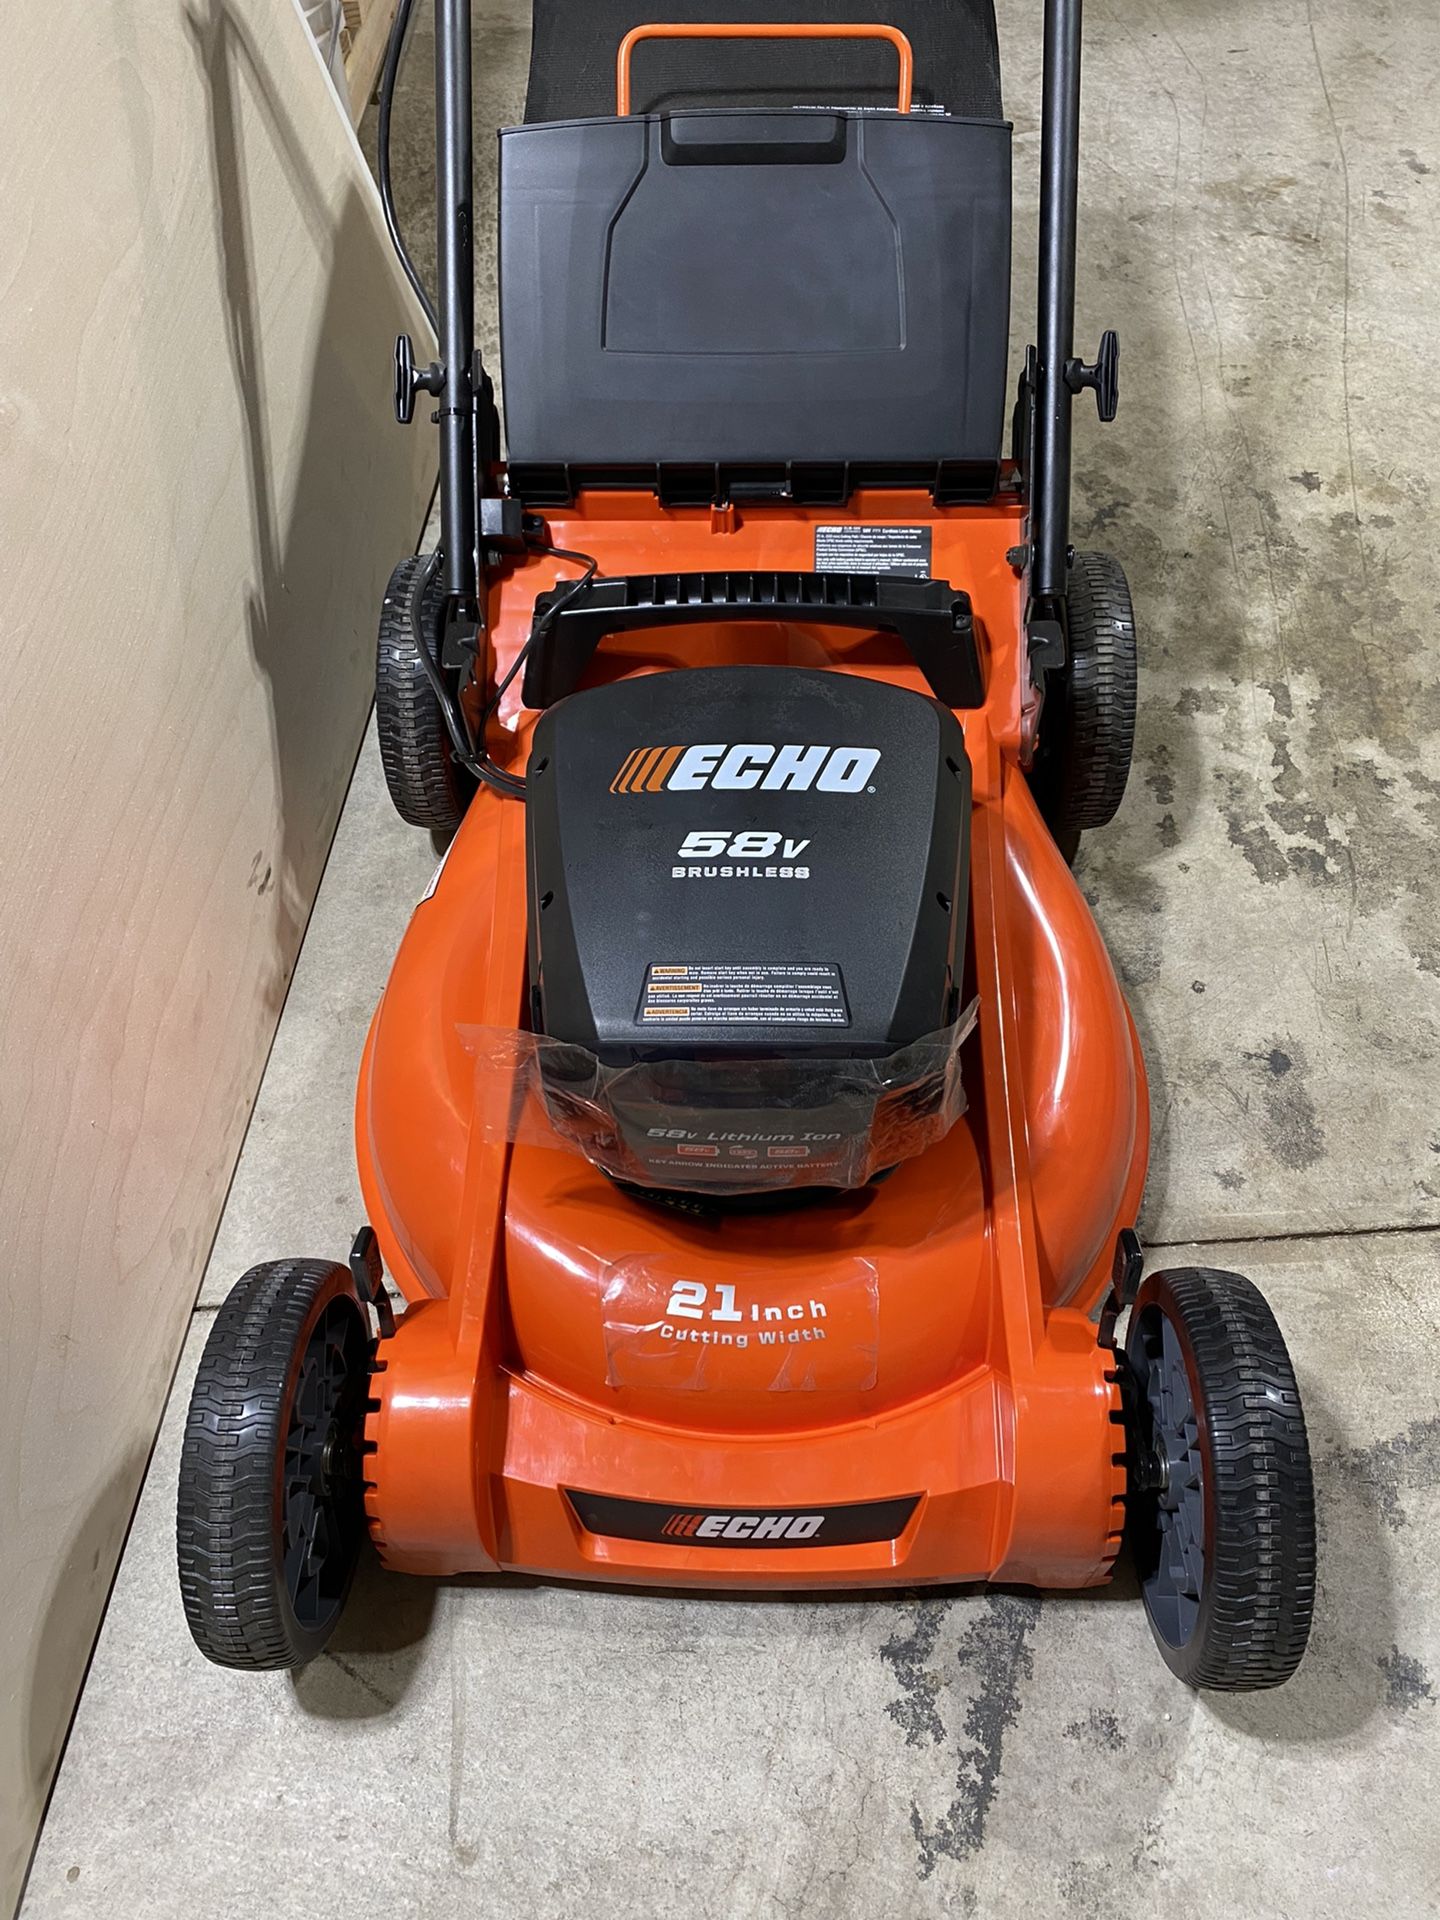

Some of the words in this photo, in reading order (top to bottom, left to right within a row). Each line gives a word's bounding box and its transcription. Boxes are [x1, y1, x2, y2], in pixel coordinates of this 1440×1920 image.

[667, 744, 882, 793] ECHO
[671, 866, 810, 879] BRUSHLESS
[707, 1132, 794, 1141] Lithium
[800, 1132, 842, 1141] Ion
[666, 1280, 742, 1322] 21
[752, 1300, 827, 1322] Inch
[660, 1324, 748, 1348] Cutting
[758, 1327, 826, 1344] Width
[695, 1516, 825, 1539] ECHO
